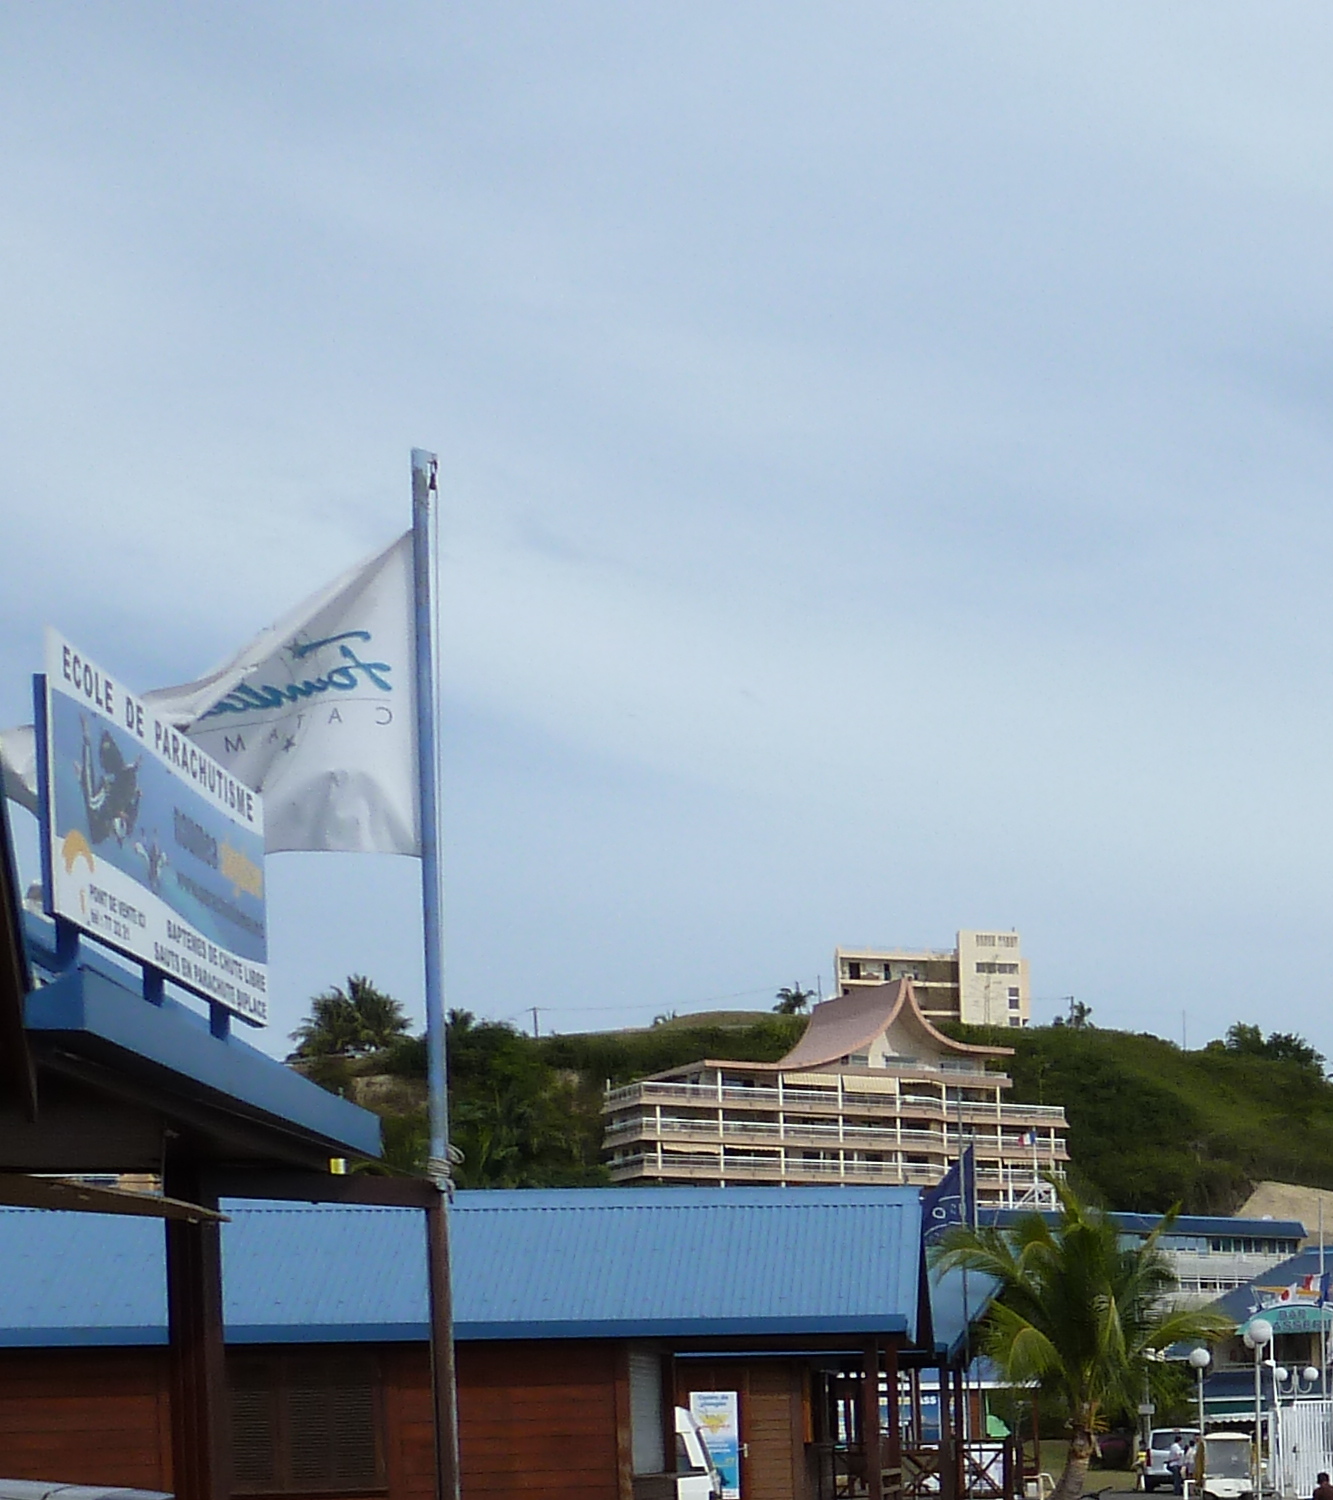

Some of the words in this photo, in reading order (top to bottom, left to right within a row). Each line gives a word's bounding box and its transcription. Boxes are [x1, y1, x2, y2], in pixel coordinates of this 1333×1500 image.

[63, 644, 114, 716] ECOLE
[125, 695, 144, 739] DE
[154, 719, 254, 823] PARACHUTISME
[207, 943, 218, 967] DE
